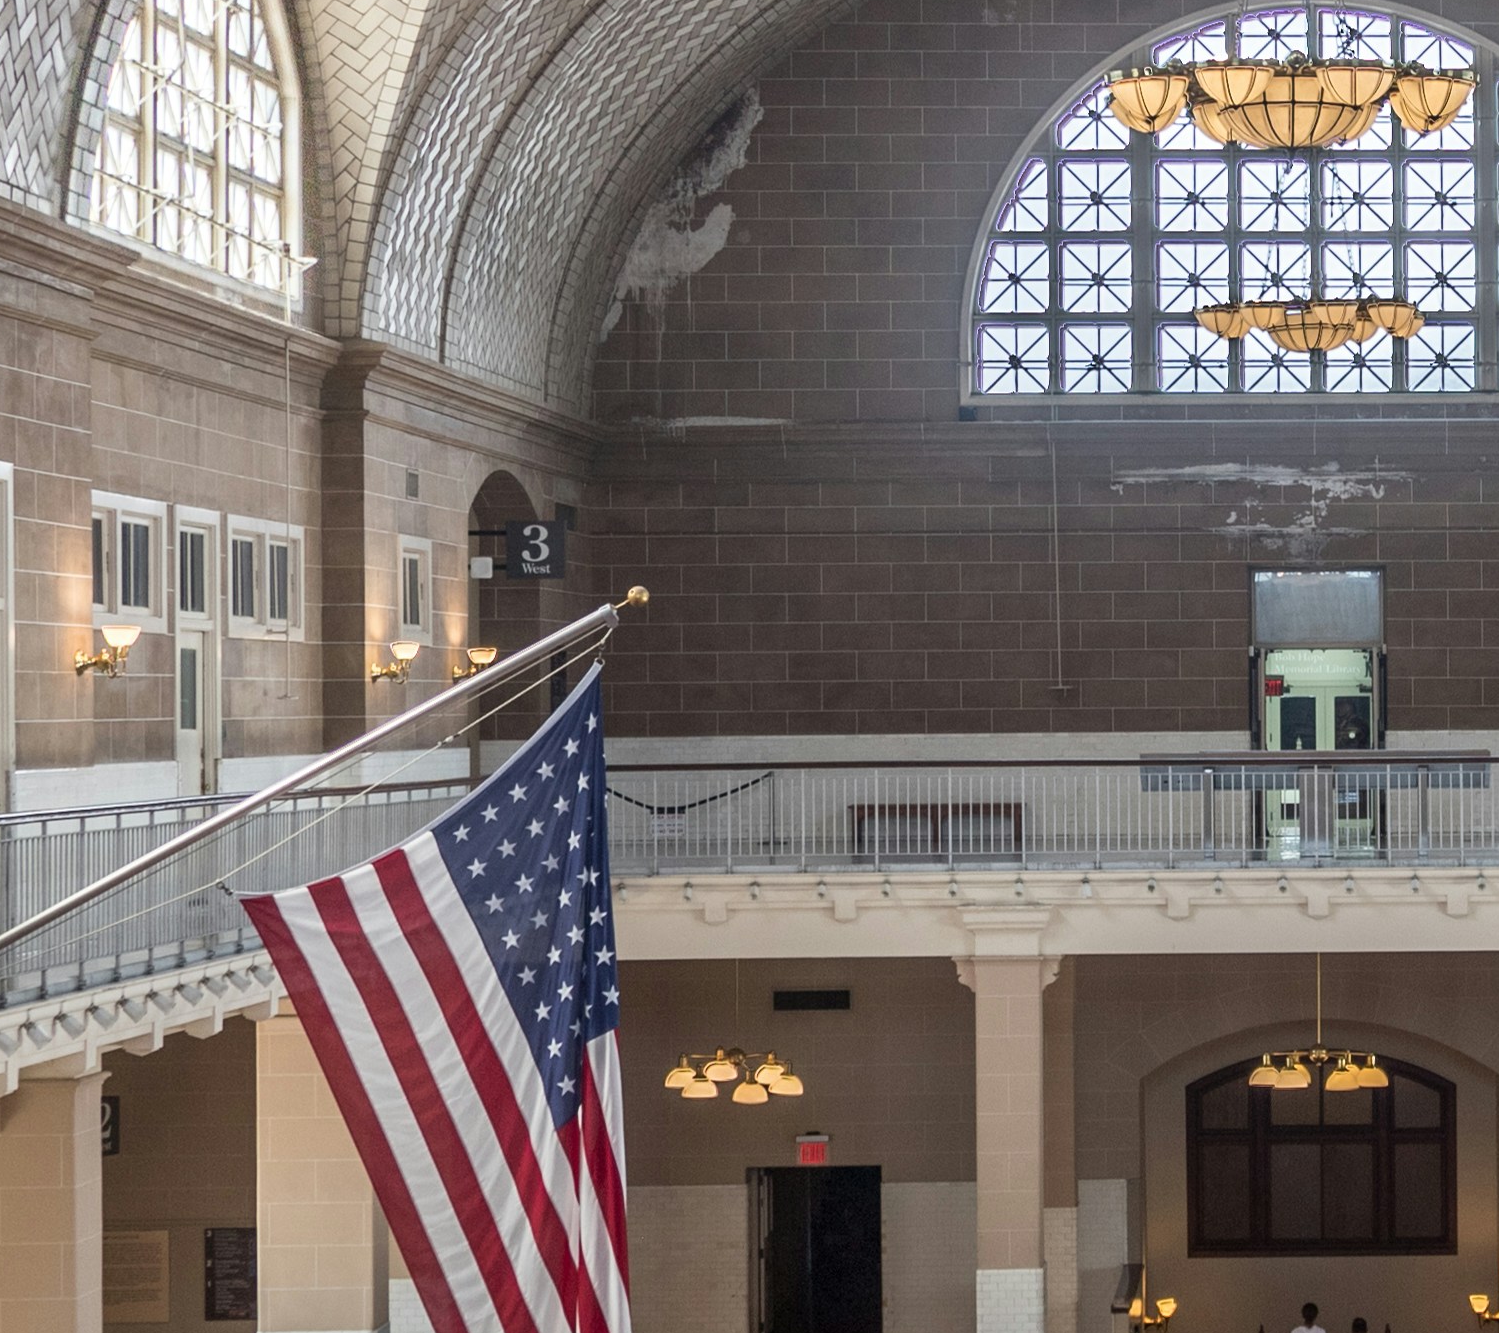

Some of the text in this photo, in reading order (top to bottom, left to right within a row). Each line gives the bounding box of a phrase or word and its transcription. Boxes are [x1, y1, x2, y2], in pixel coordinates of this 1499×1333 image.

[521, 524, 550, 562] 3
[521, 562, 551, 574] West
[1274, 652, 1323, 663] Bob Hope
[1274, 665, 1362, 675] Memorial Library
